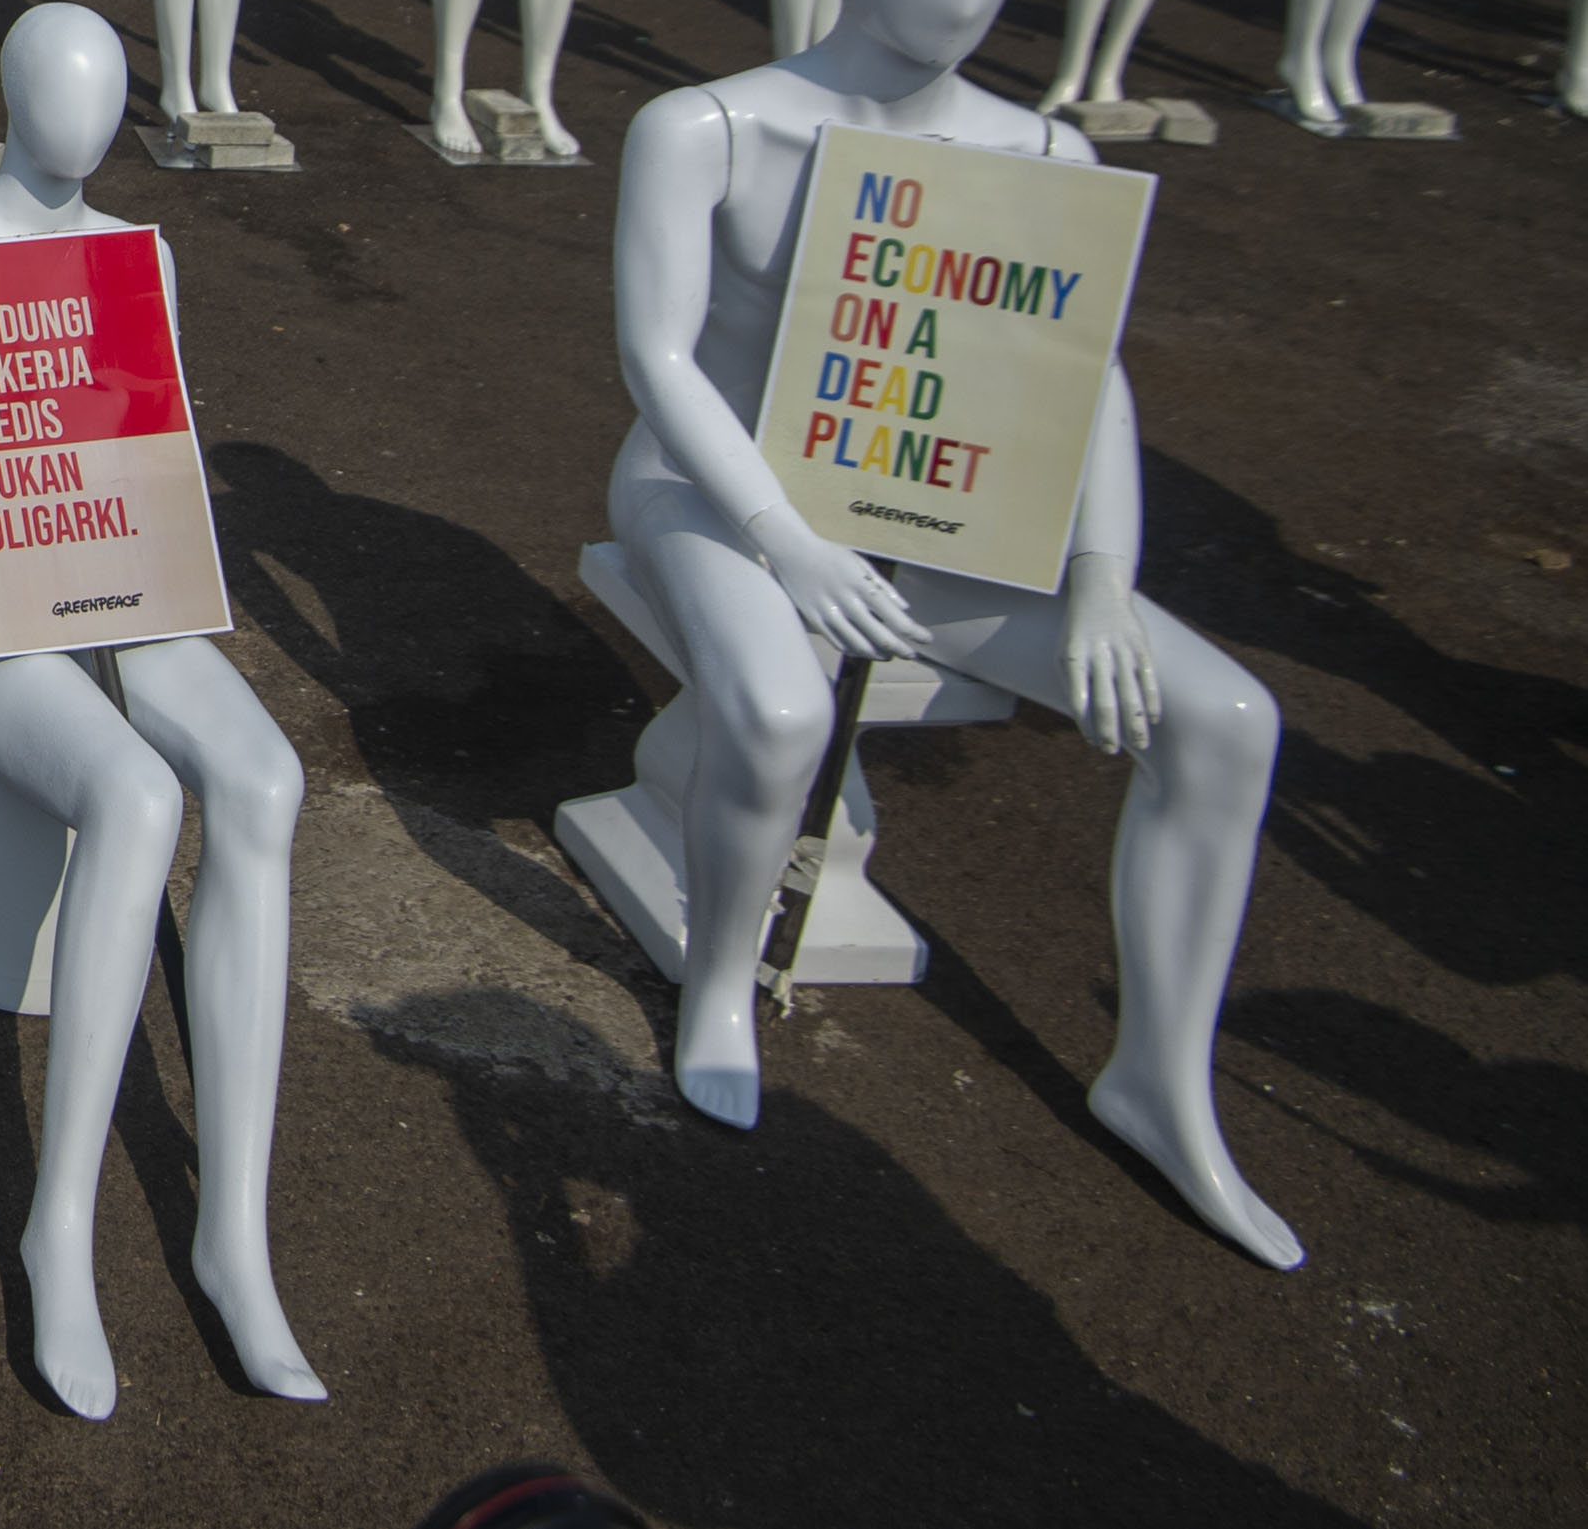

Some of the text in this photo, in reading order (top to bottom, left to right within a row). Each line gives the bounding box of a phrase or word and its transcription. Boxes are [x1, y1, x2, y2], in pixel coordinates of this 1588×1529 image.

[854, 172, 923, 229] NO
[842, 231, 1082, 320] ECONOMY
[829, 292, 938, 359] ON A
[816, 351, 943, 421] DEAD
[802, 410, 990, 493] PLANET
[848, 499, 965, 535] GREENPEACE
[51, 593, 143, 617] GREENPEACE
